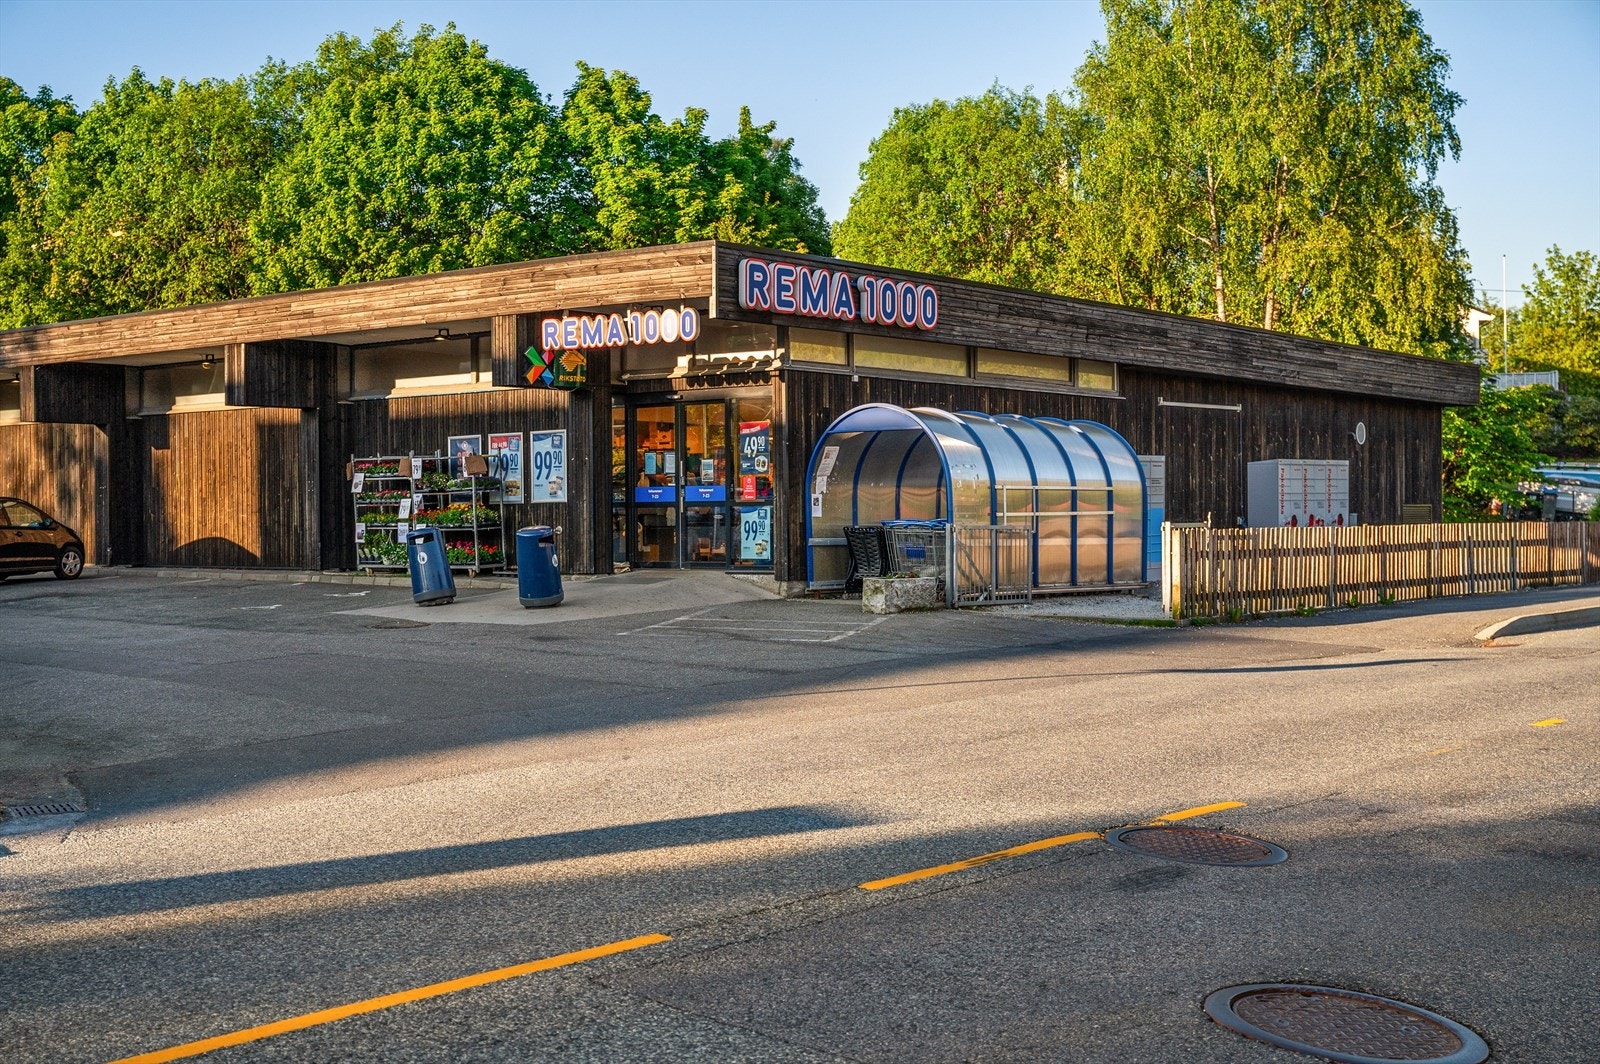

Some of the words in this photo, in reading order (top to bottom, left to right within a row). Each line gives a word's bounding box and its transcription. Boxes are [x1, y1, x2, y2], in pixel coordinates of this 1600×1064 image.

[740, 258, 855, 321] REMA
[858, 275, 938, 331] 1000
[542, 313, 627, 350] REMA
[631, 307, 698, 345] 1000
[510, 453, 518, 467] 90
[744, 436, 758, 458] 49
[535, 451, 553, 480] 99
[553, 450, 562, 465] 90
[744, 520, 758, 541] 99
